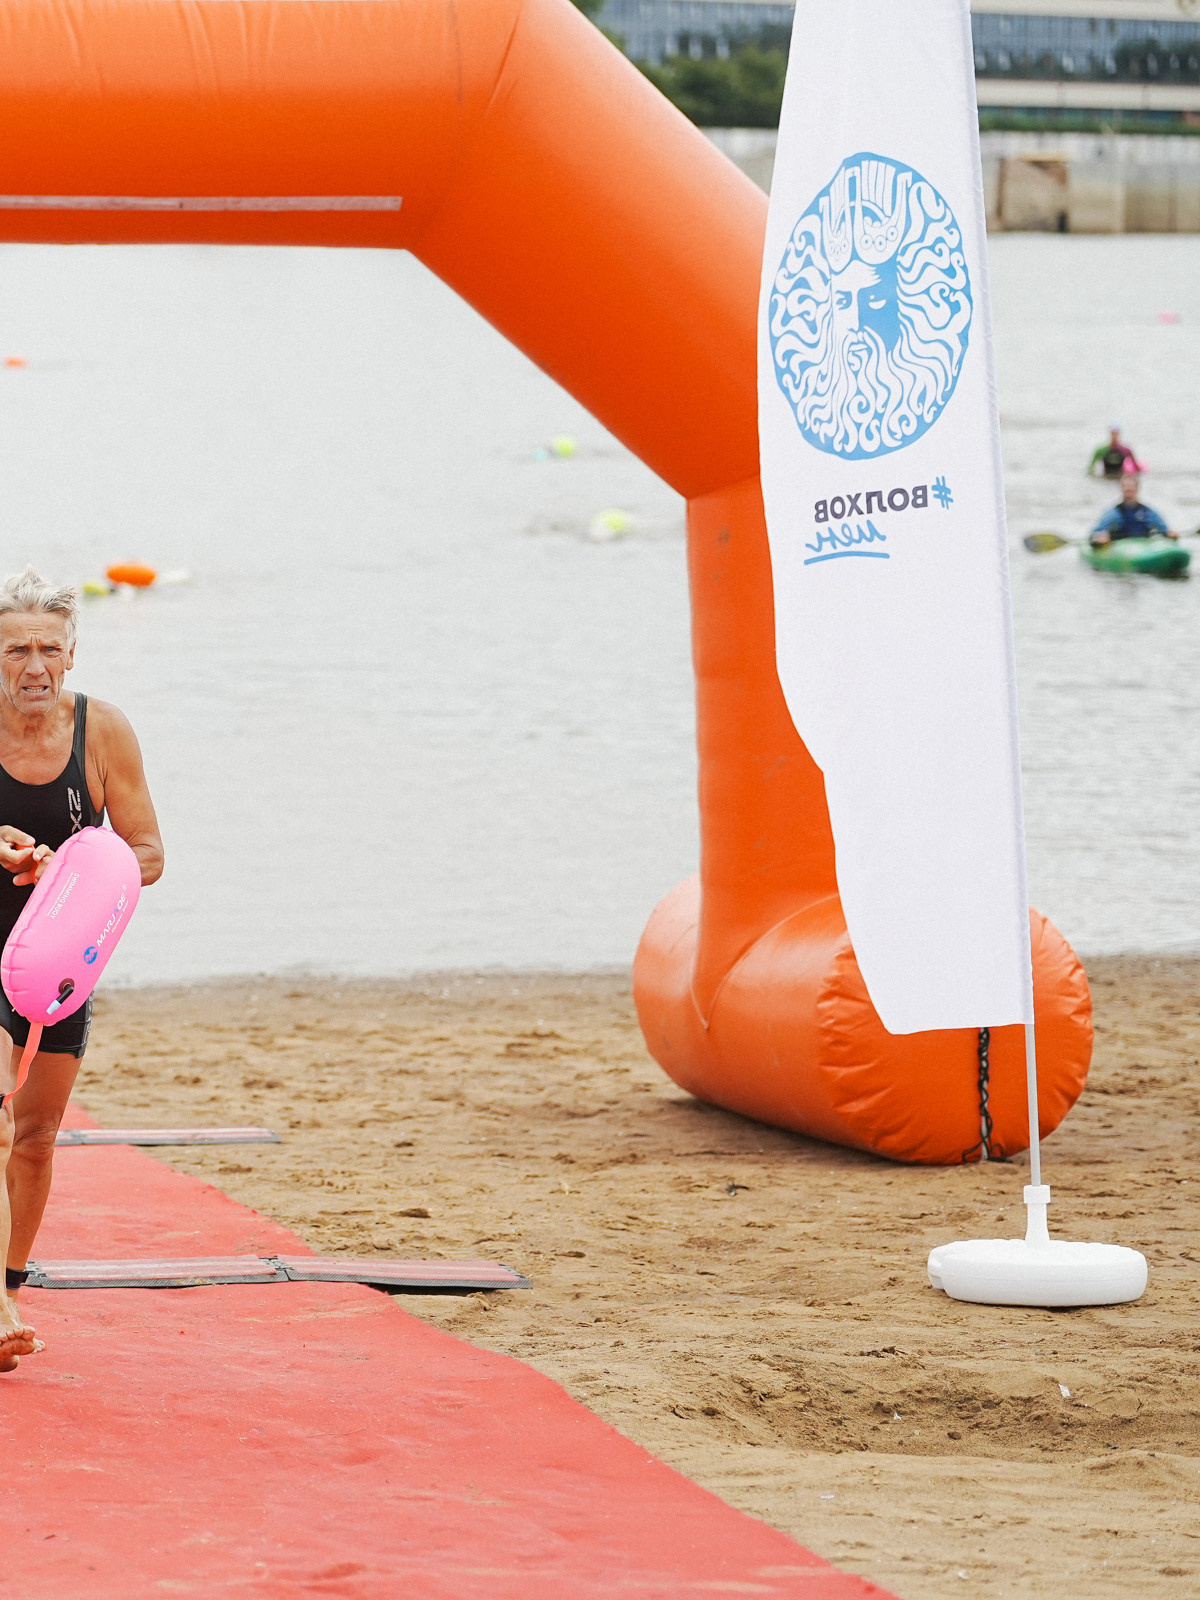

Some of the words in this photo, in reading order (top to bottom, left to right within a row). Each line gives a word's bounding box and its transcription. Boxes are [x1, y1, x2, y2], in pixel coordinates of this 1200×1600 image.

[67, 787, 83, 834] 2X
[60, 872, 80, 904] SWIMMING
[50, 903, 63, 919] BUOY
